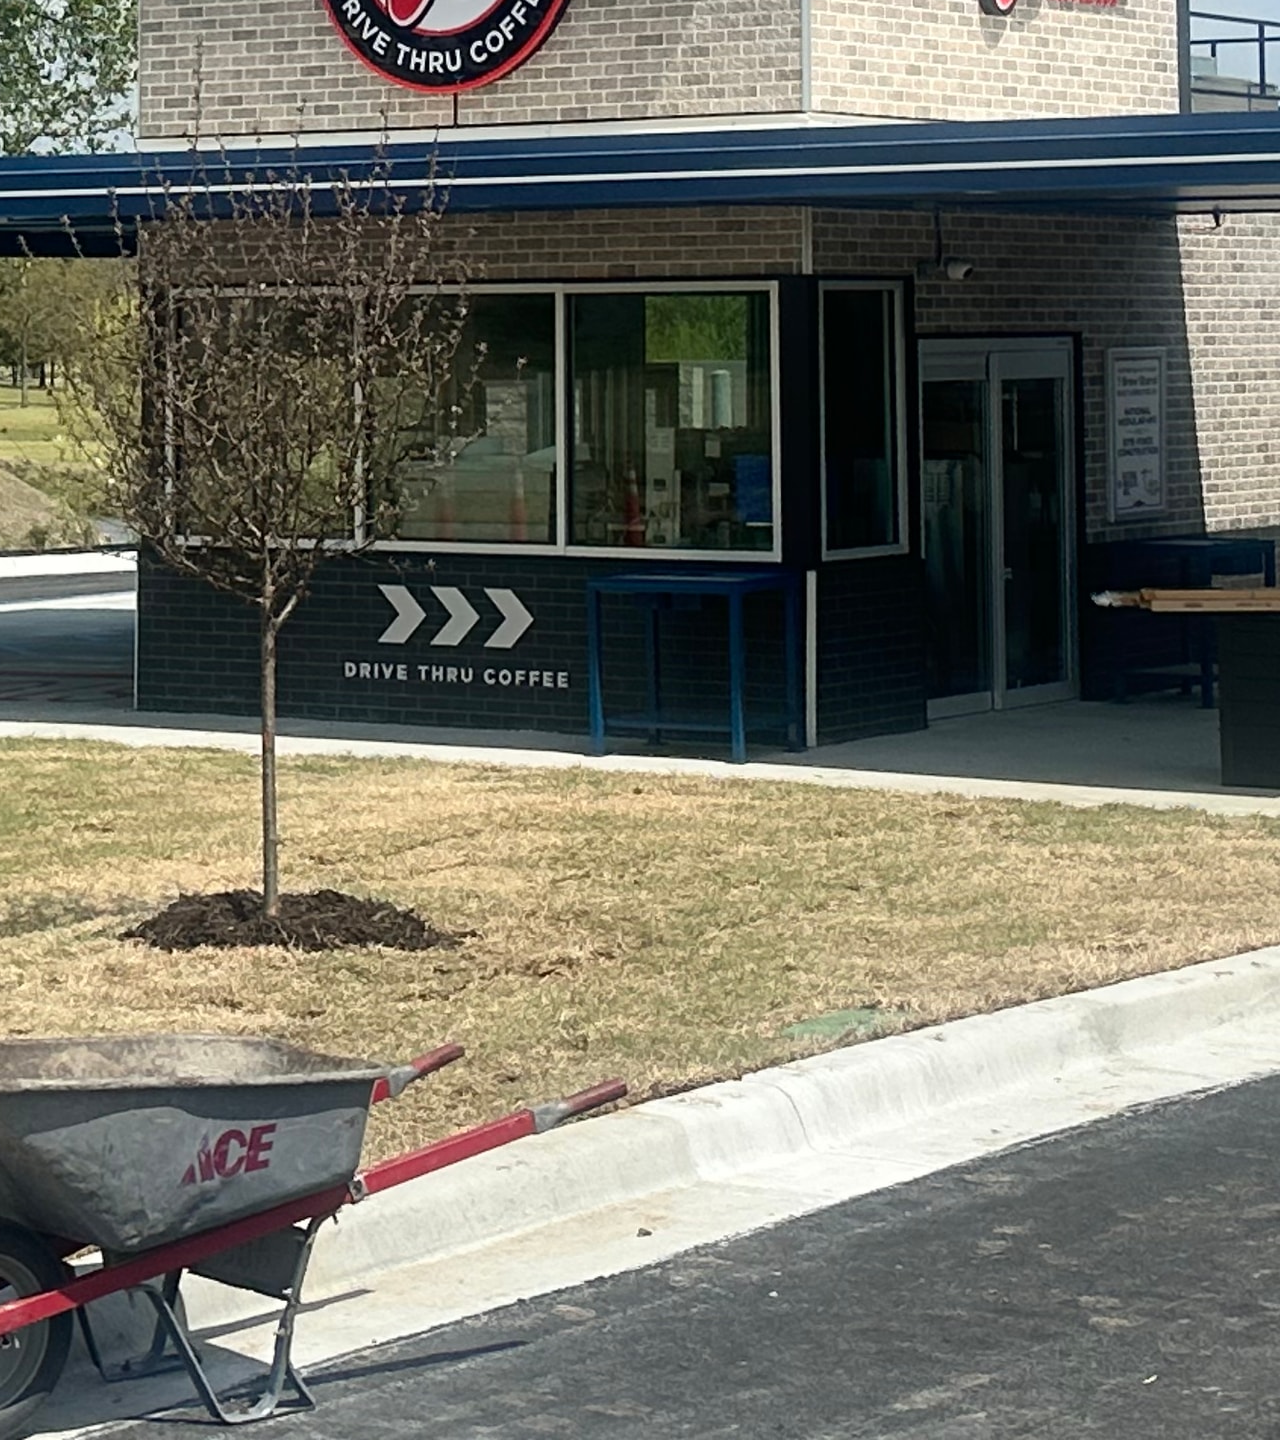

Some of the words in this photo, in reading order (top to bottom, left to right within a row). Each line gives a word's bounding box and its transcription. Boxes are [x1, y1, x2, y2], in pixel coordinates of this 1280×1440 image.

[396, 43, 462, 73] THRU
[344, 662, 408, 681] DRIVE
[418, 665, 474, 683] THRU
[483, 669, 569, 689] COFFEE
